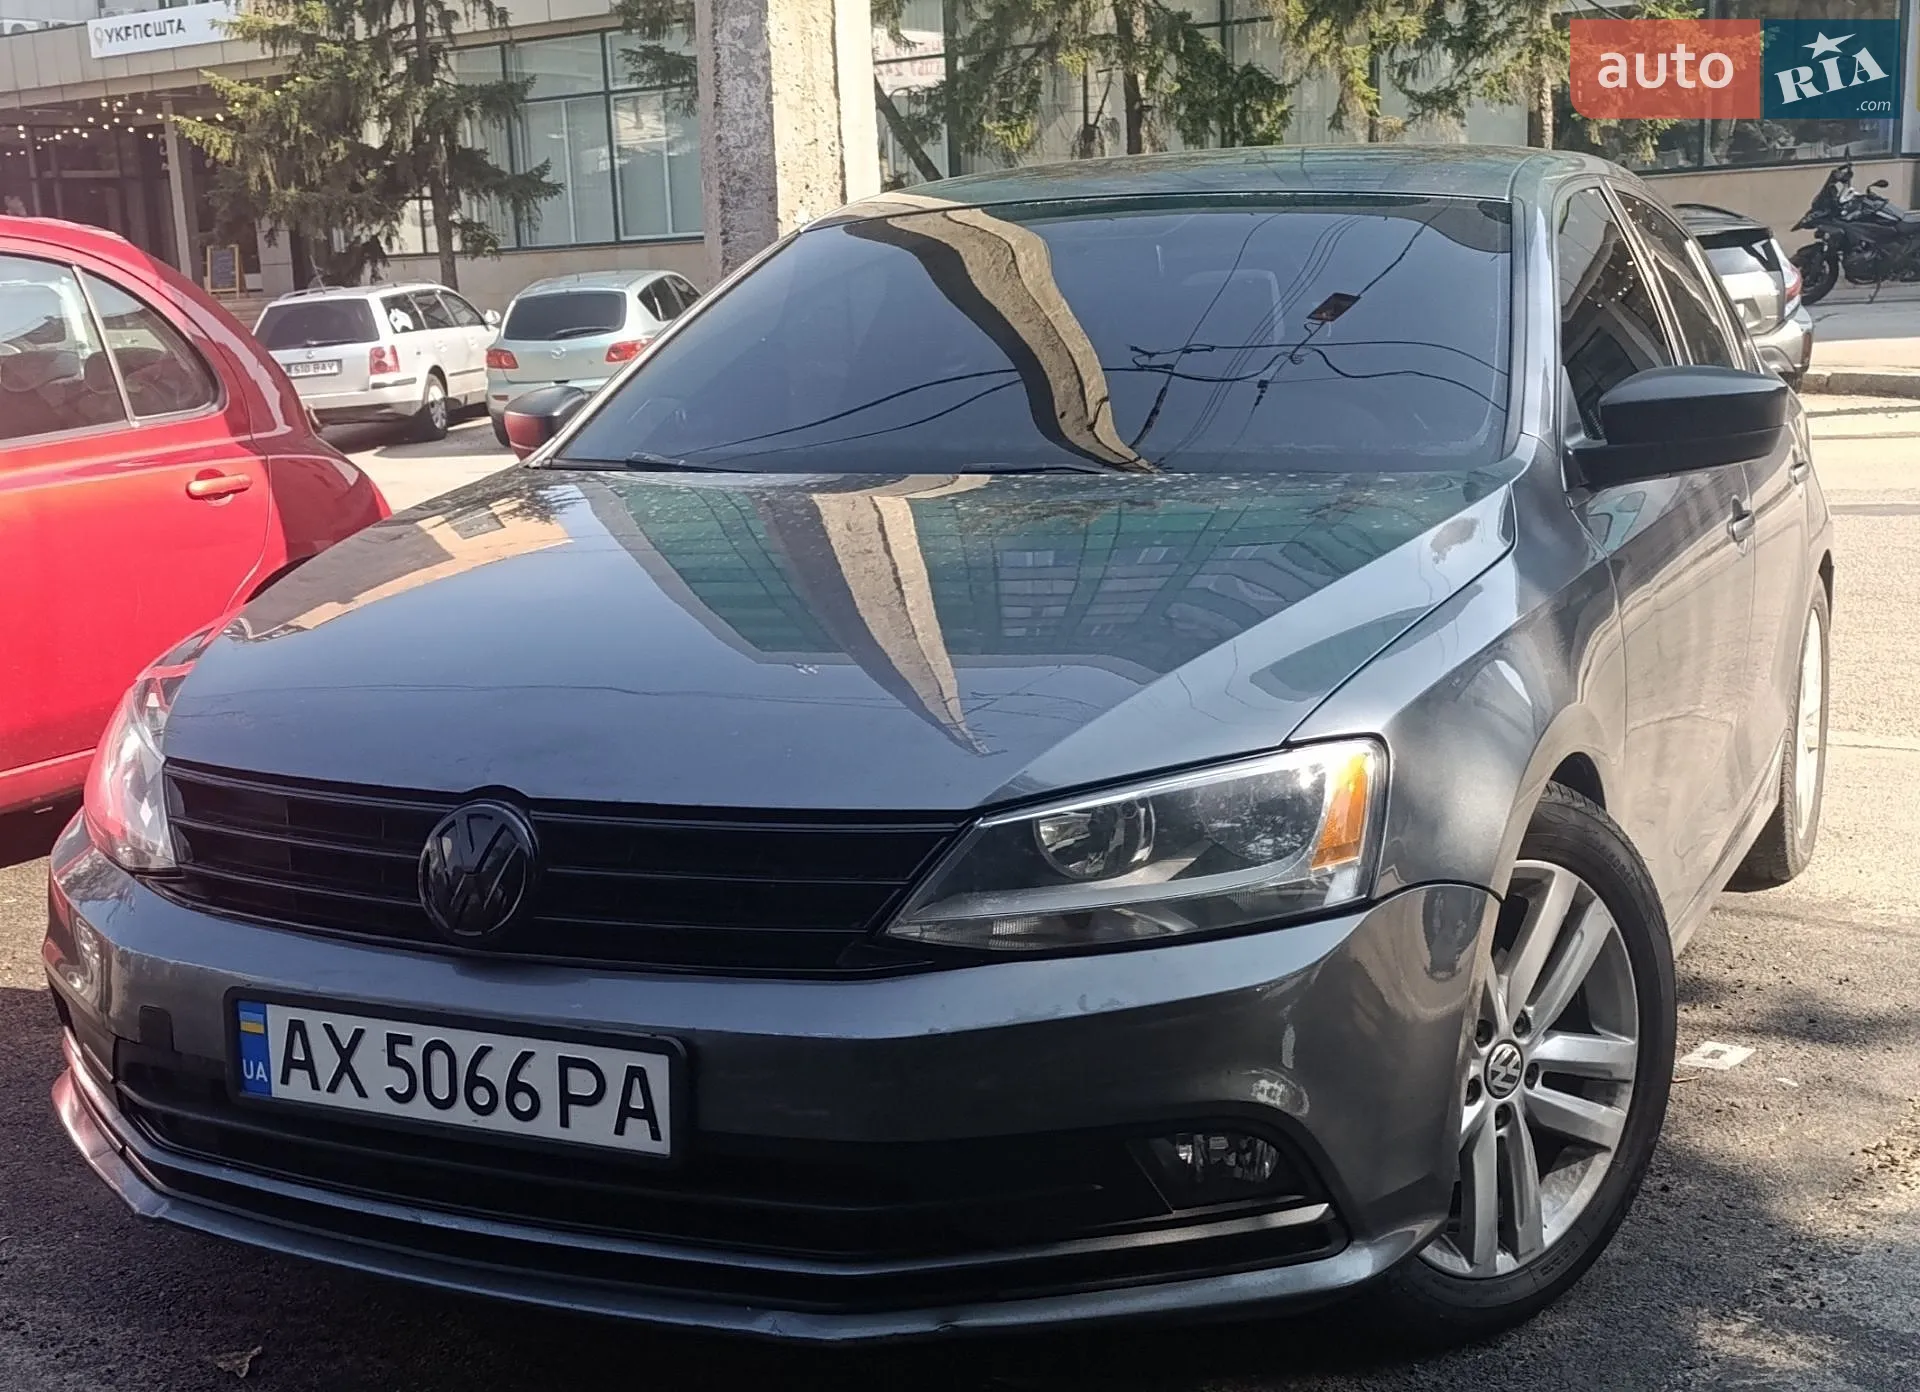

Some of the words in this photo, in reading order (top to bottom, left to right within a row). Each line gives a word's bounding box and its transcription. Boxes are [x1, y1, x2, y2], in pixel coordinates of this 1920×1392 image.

[104, 18, 186, 43] УКРПОШТА
[243, 1058, 269, 1082] UA
[280, 1018, 369, 1098] AX
[385, 1032, 541, 1123] 5066
[558, 1055, 663, 1142] PA
